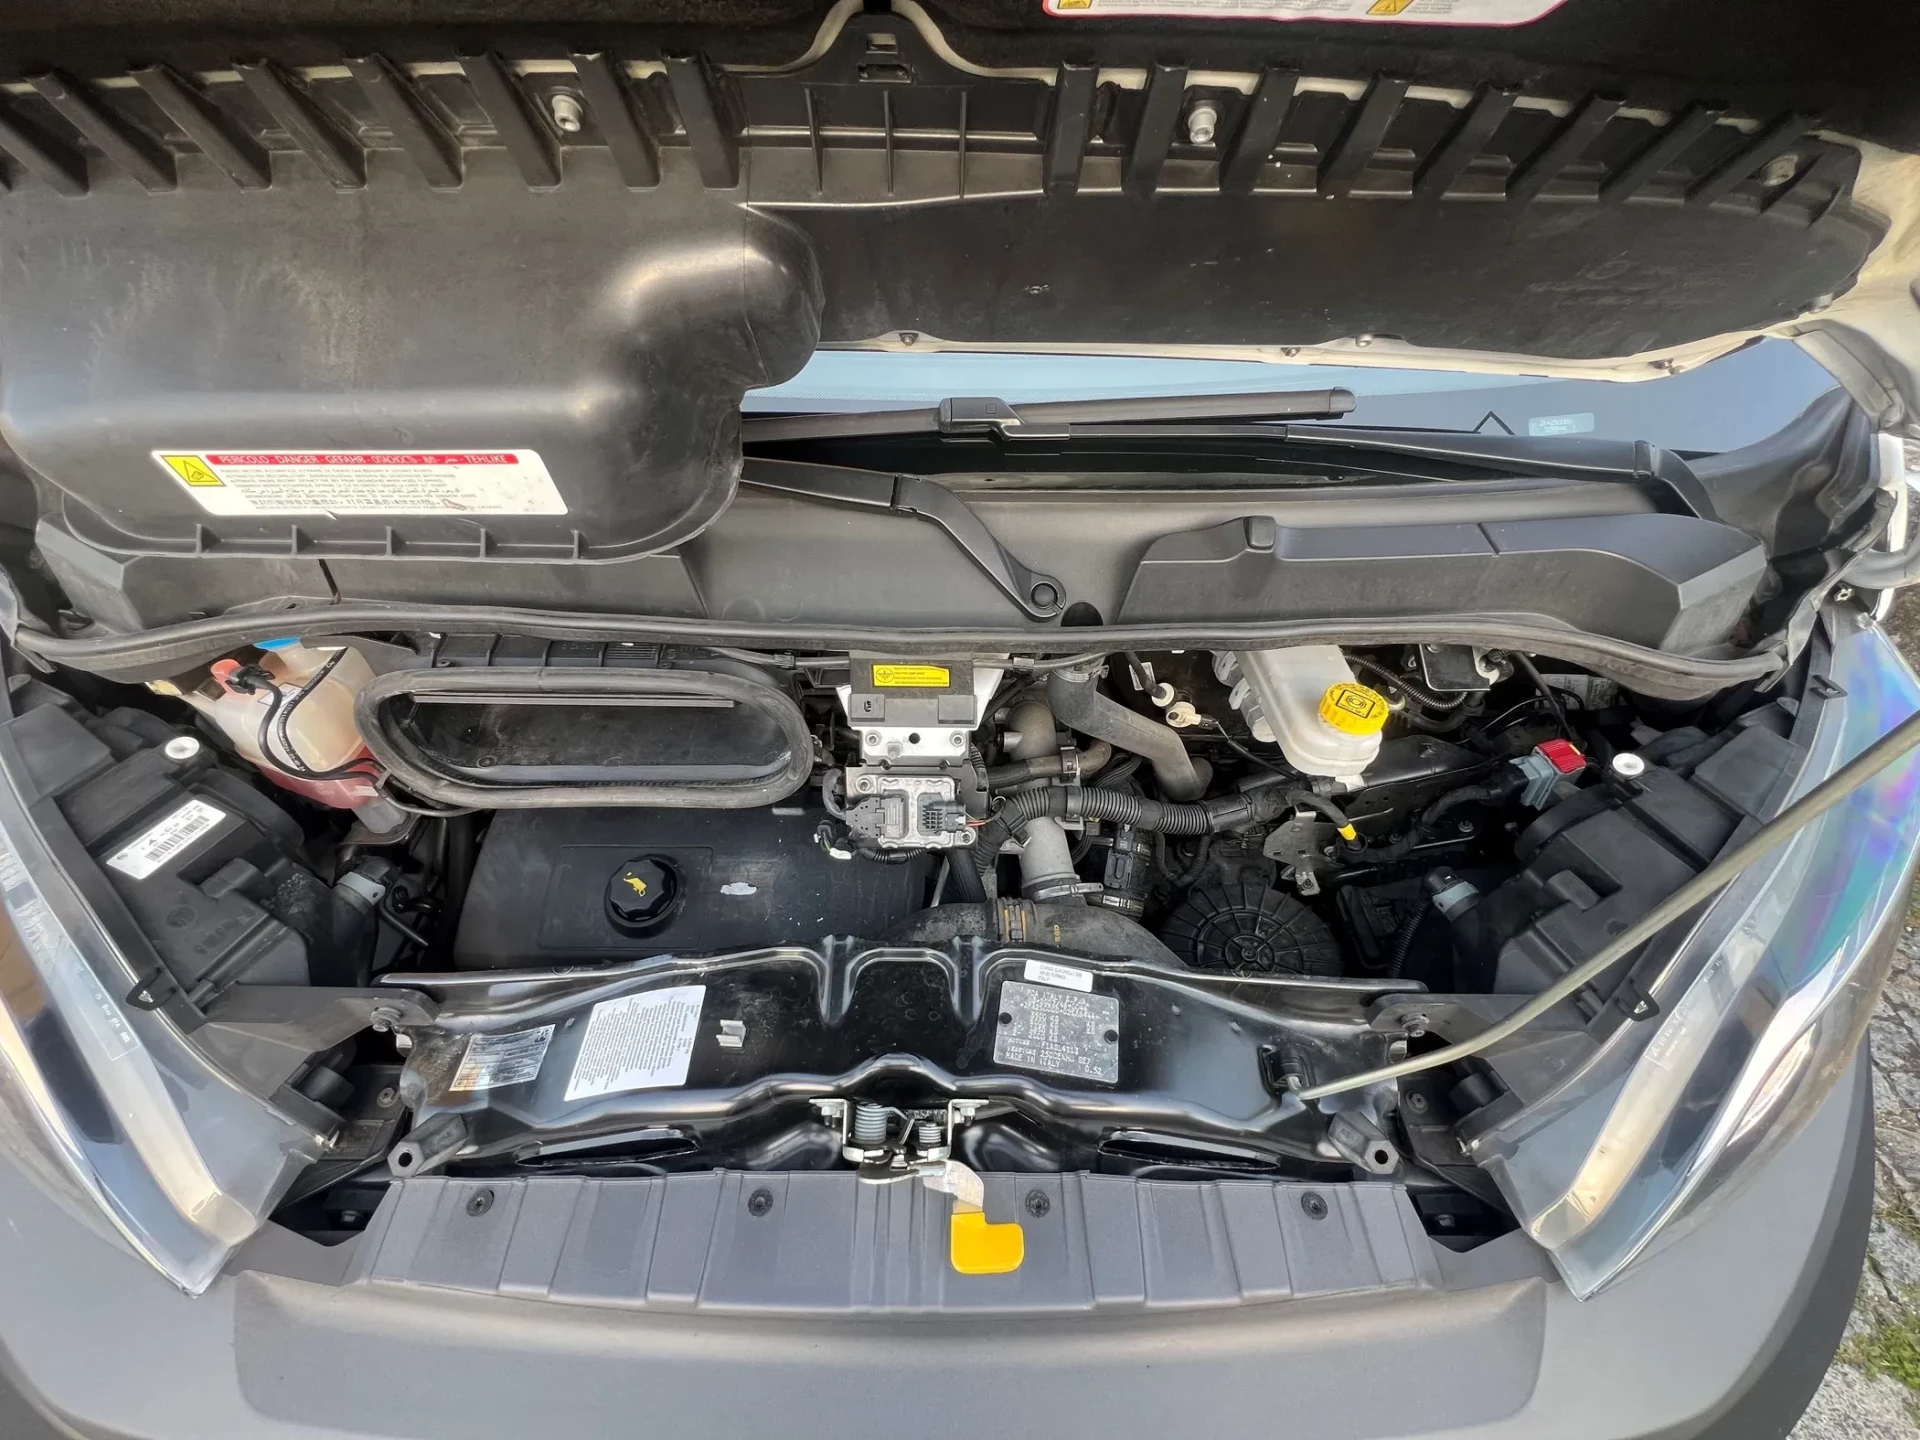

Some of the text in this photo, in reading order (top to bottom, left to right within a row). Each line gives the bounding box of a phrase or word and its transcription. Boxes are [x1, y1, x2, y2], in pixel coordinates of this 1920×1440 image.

[218, 455, 270, 465] PERICOLO
[274, 455, 321, 465] DANGER
[324, 455, 367, 465] GEFAHR
[464, 455, 508, 464] TEHLIKE
[1043, 991, 1062, 1000] ITALY
[1039, 1057, 1060, 1067] ITALY
[1084, 1064, 1102, 1075] 0.52
